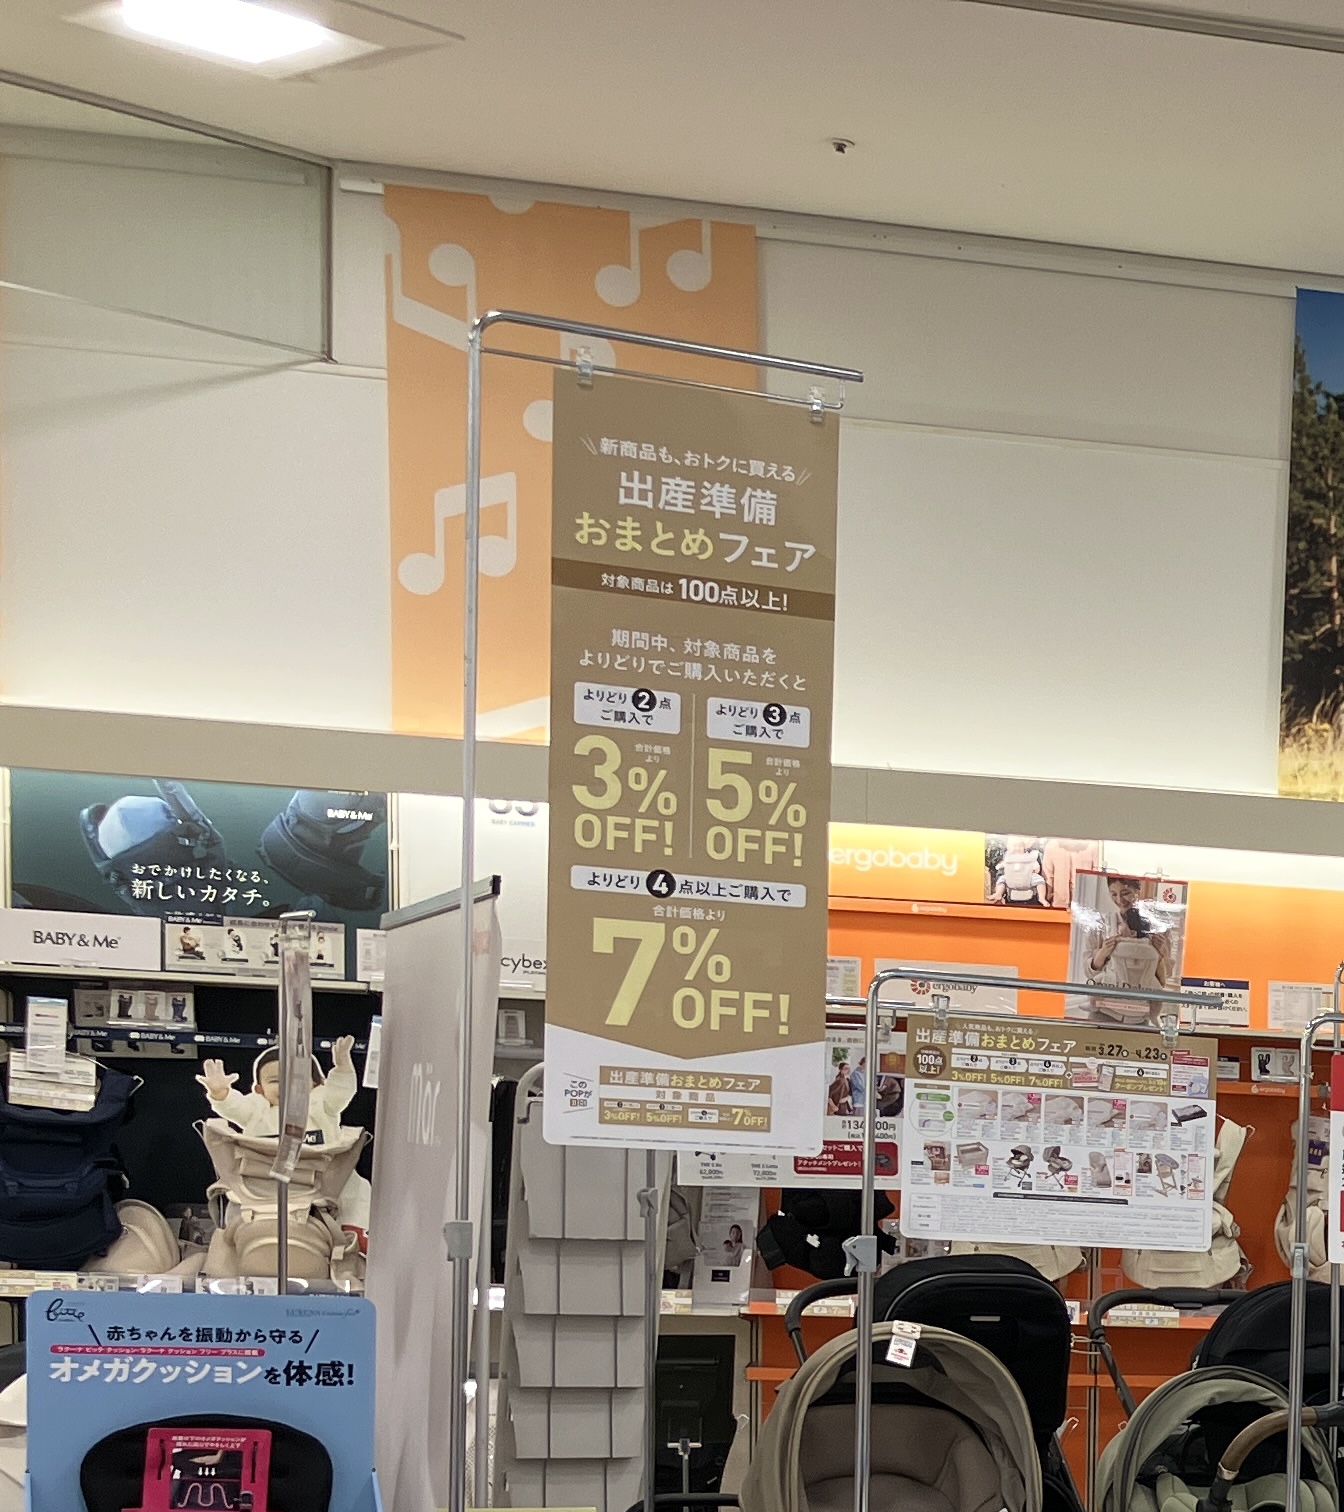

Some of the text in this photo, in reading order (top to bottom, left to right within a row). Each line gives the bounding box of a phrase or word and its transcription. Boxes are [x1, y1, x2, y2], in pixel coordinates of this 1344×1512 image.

[600, 436, 797, 483] 新商品も、おトクに買える
[617, 470, 778, 526] 出産準備
[574, 511, 817, 573] おまとめフェア
[600, 572, 789, 612] 対象商品は100点以上!
[610, 627, 778, 666] 期間中、対象商品を
[578, 649, 807, 692] よりどりでご購入いただくと
[600, 707, 655, 727] ご購入で
[731, 722, 786, 742] ご購入で
[573, 812, 674, 857] OFF!
[705, 825, 804, 867] OFF!
[130, 863, 270, 884] おでかけしたくなる、
[130, 877, 271, 908] 新しいカタチ。
[652, 904, 727, 922] 合計価格より
[671, 986, 791, 1036] OFF!
[914, 1028, 1077, 1054] 出産準備おまとめフェア
[916, 1053, 944, 1066] 100点
[918, 1064, 941, 1077] 以上!
[608, 1069, 762, 1092] 出産準備おまとめフェア
[106, 1325, 304, 1345] 赤ちゃんを振動から守る
[49, 1356, 356, 1387] オメガクッションを体感!
